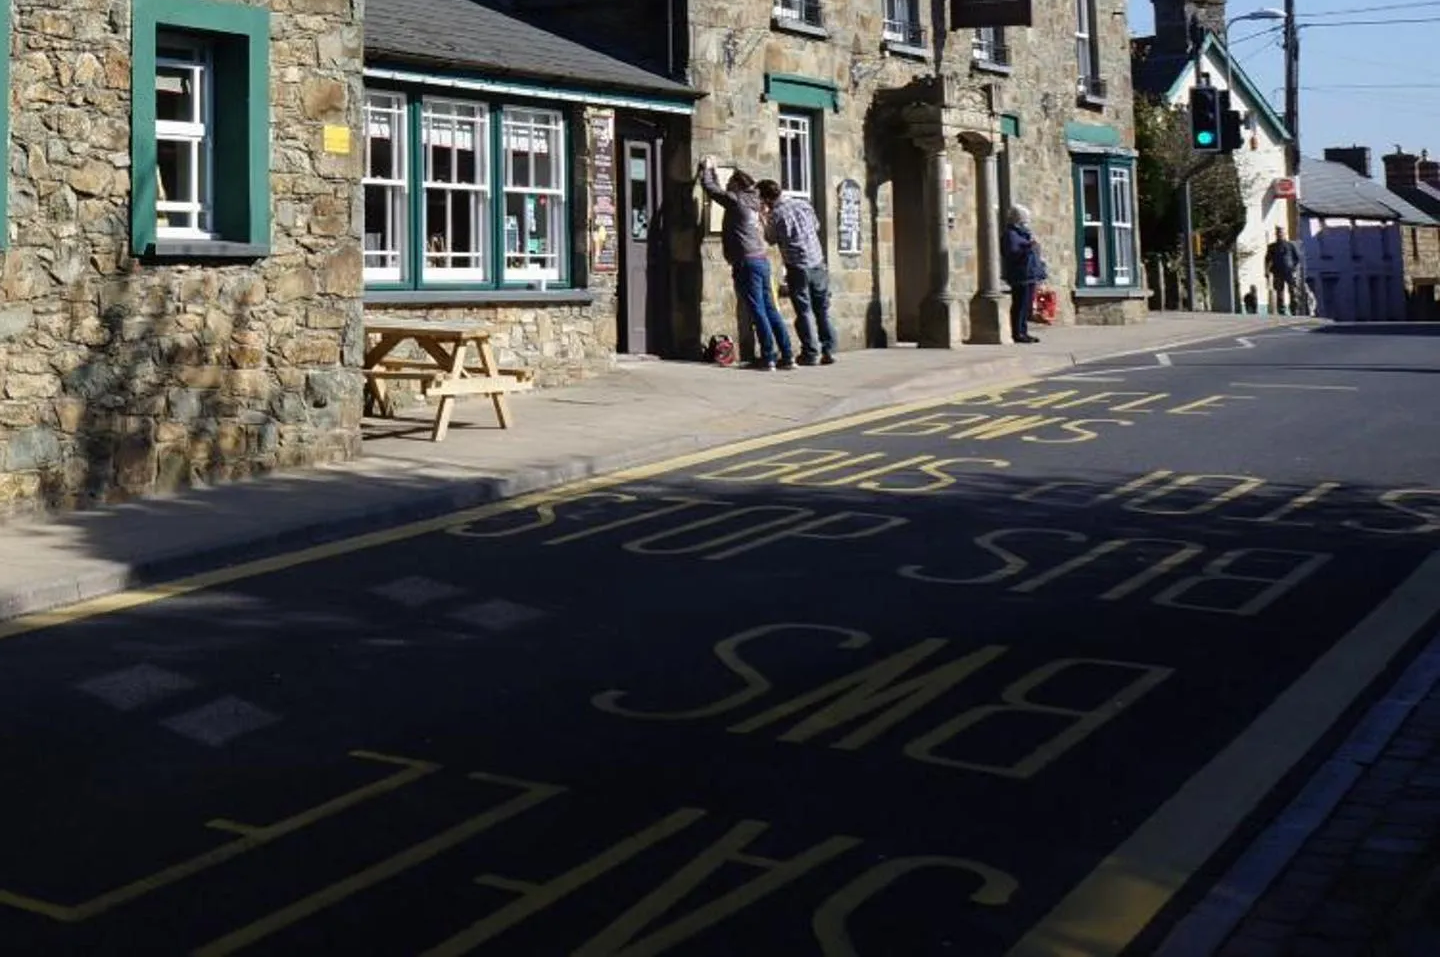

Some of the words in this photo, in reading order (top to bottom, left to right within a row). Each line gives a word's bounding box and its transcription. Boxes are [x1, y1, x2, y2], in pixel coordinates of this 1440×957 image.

[693, 448, 1011, 493] BUS
[444, 492, 911, 561] STOP
[896, 528, 1335, 617] BUS
[590, 622, 1176, 779] BWS
